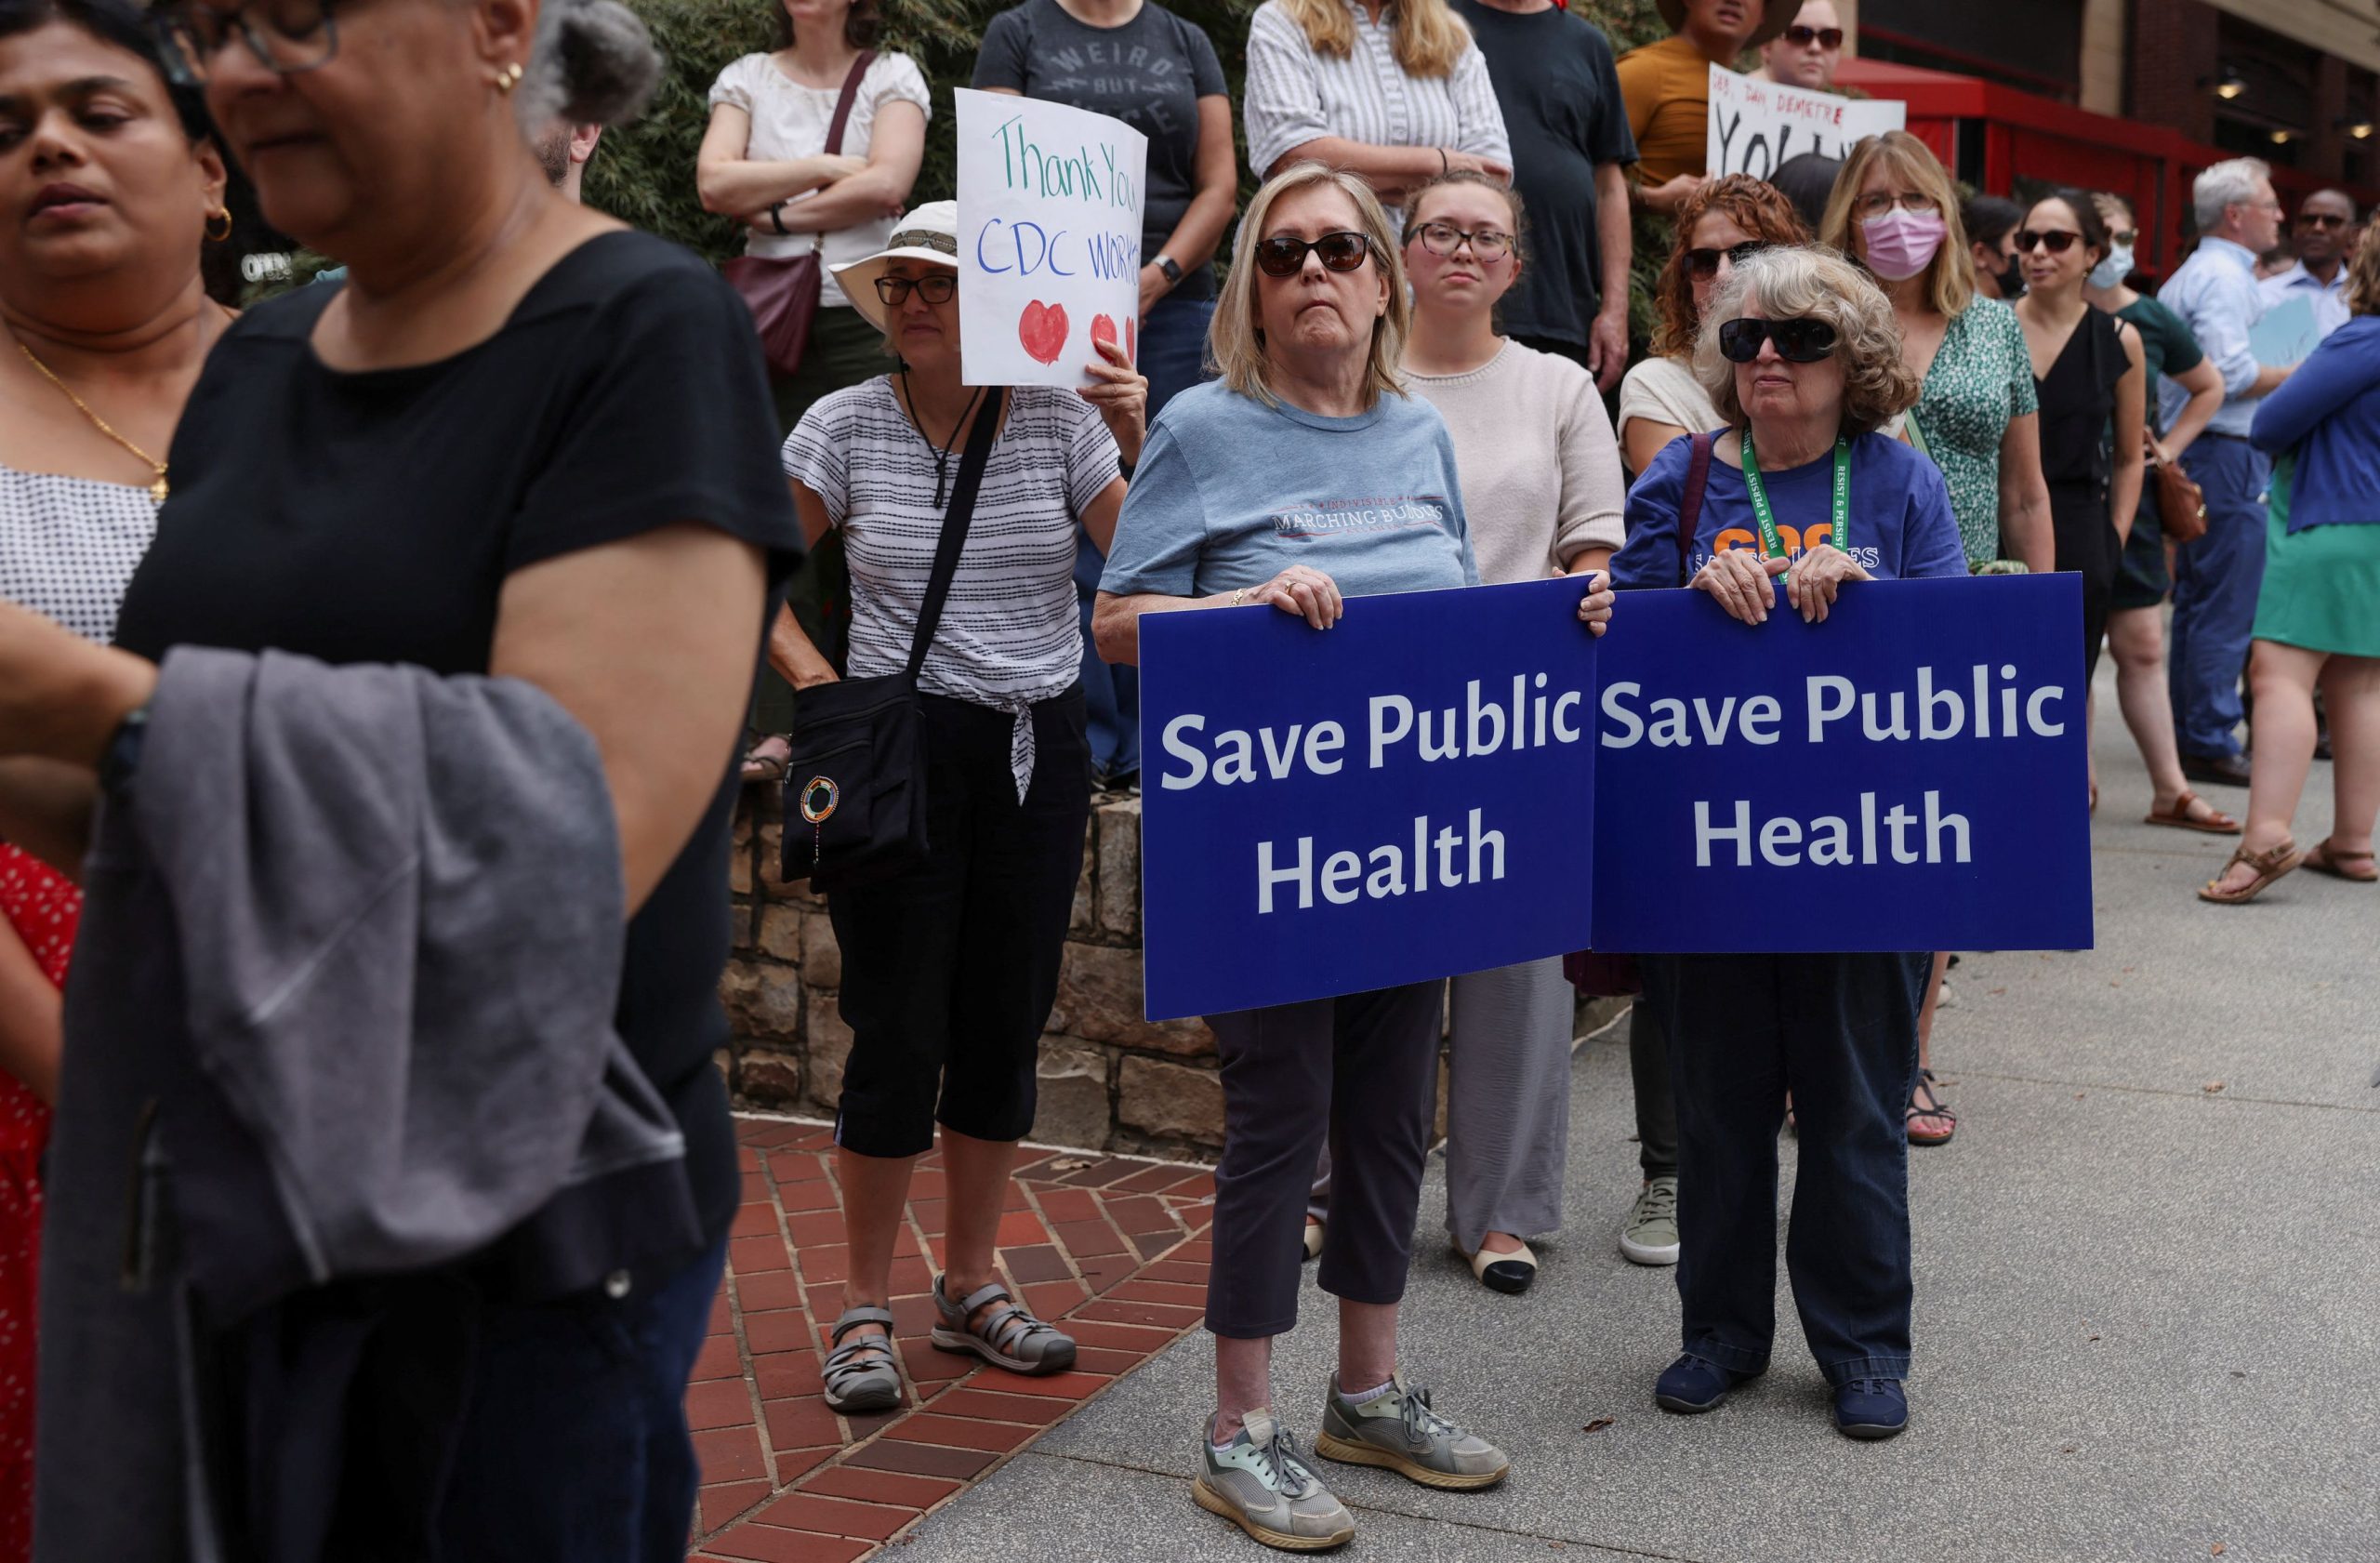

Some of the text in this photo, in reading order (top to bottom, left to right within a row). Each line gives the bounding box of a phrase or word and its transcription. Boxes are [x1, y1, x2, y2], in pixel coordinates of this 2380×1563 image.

[1051, 42, 1173, 76] WEIRD
[1093, 77, 1138, 93] BUT
[992, 114, 1102, 202] Thank
[977, 218, 1075, 276] CDC
[1748, 472, 1765, 508] PERSIST
[1837, 465, 1846, 497] RESIST
[1272, 510, 1377, 531] MARCHING
[1327, 497, 1396, 510] INDIVISIBLE
[1761, 519, 1777, 550] RESIST
[1835, 510, 1844, 548] PERSIST
[1600, 664, 2065, 748] Save Public
[1160, 672, 1581, 790] Save Public
[1693, 789, 1971, 868] Health
[1257, 807, 1505, 915] Health
